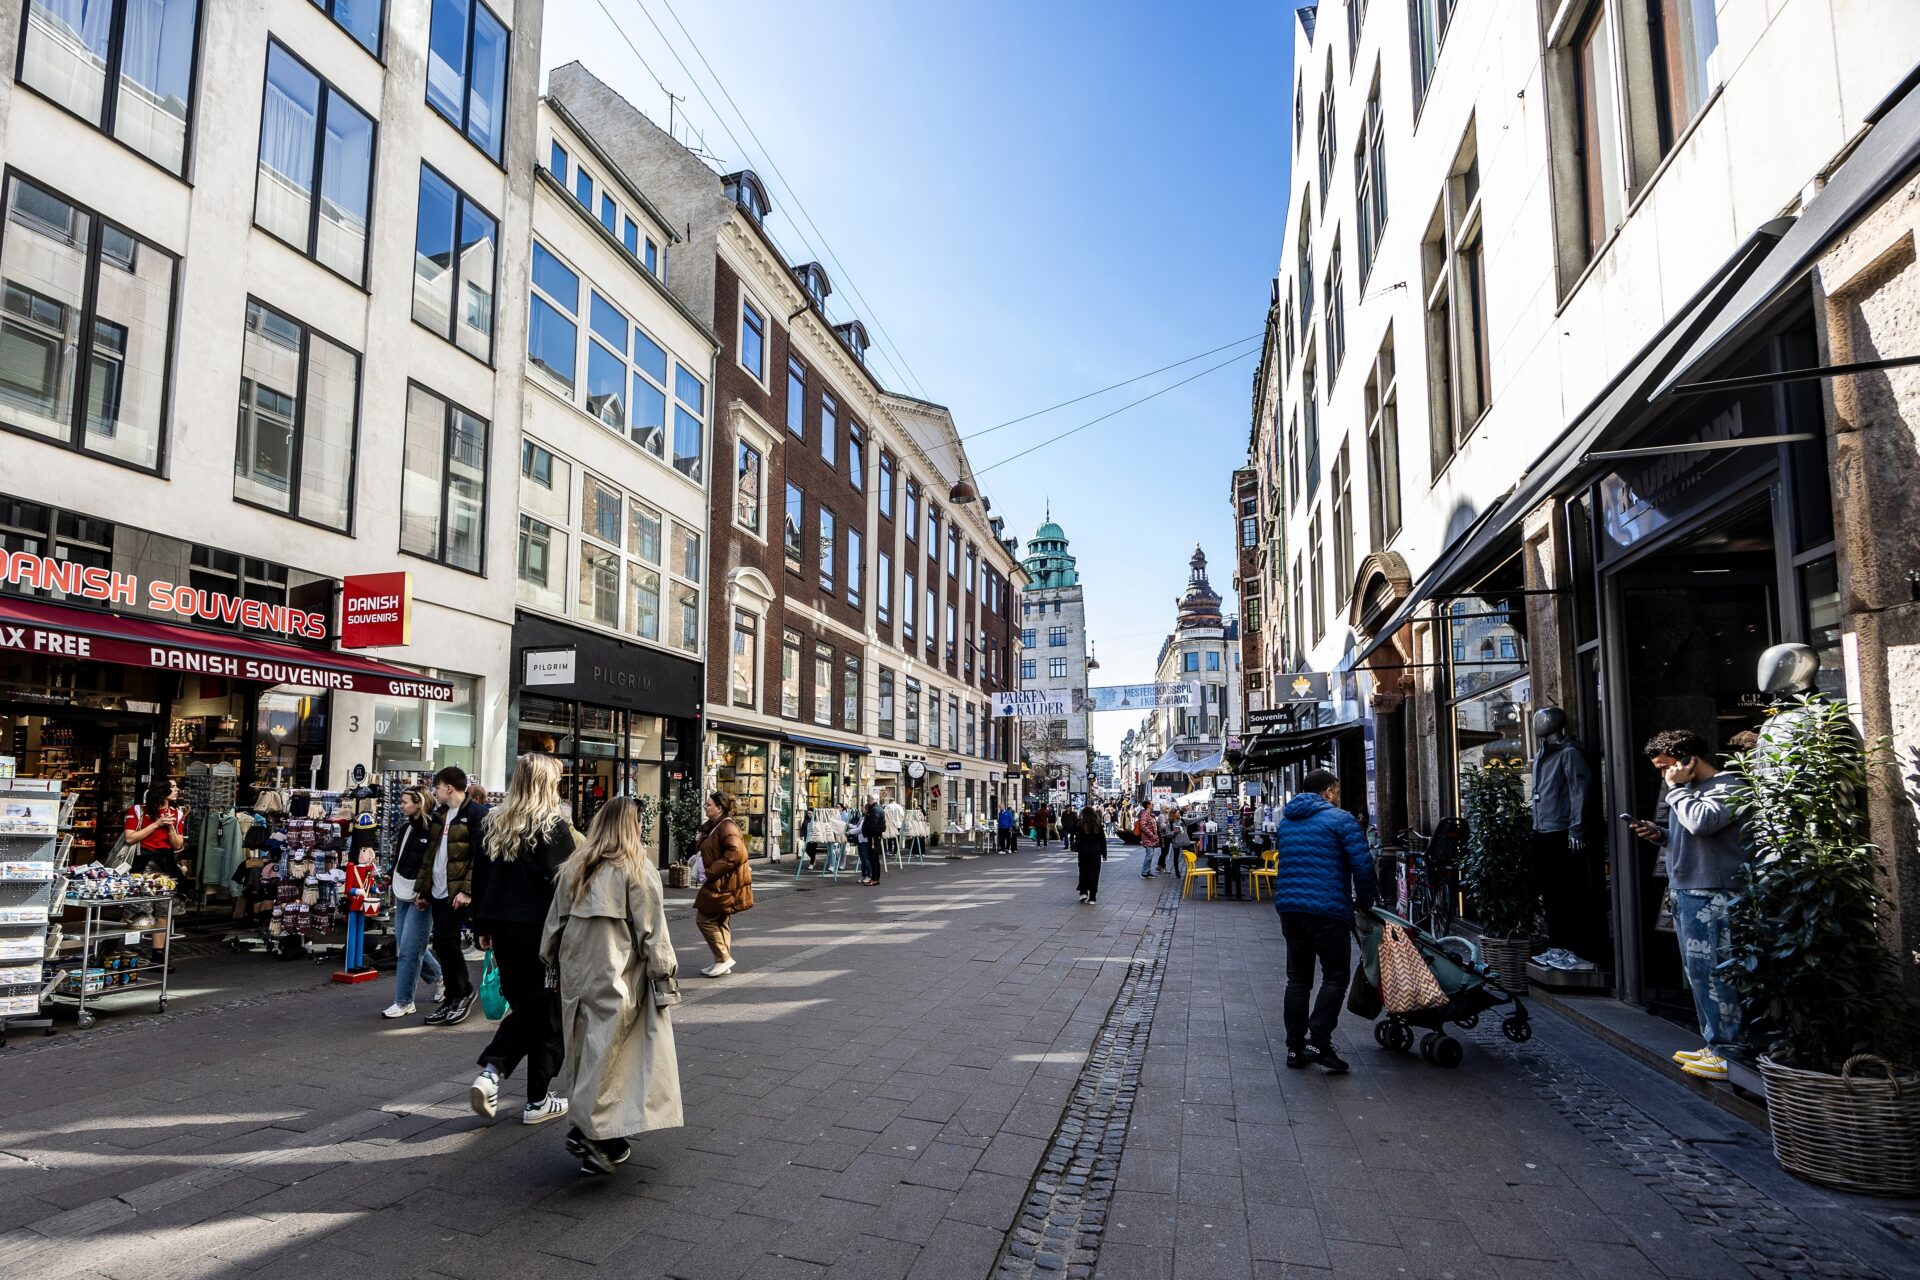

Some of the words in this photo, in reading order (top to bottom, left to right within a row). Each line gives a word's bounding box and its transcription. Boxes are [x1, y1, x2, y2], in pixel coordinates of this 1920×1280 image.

[0, 548, 137, 605] ANISH
[148, 580, 326, 639] SOUVENIRS
[348, 595, 399, 612] DANISH
[347, 613, 398, 624] SOUVENIRS
[34, 630, 90, 657] FREE
[150, 648, 238, 676] DANISH
[246, 661, 354, 690] SOUVENIRS
[533, 663, 568, 671] PILGRIM
[593, 666, 652, 692] PILGRIM
[389, 681, 451, 700] GIFTSHOP
[1000, 690, 1046, 704] PARKEN
[1016, 702, 1064, 715] KALDER
[349, 715, 360, 733] 3
[1250, 713, 1288, 722] Souvenirs
